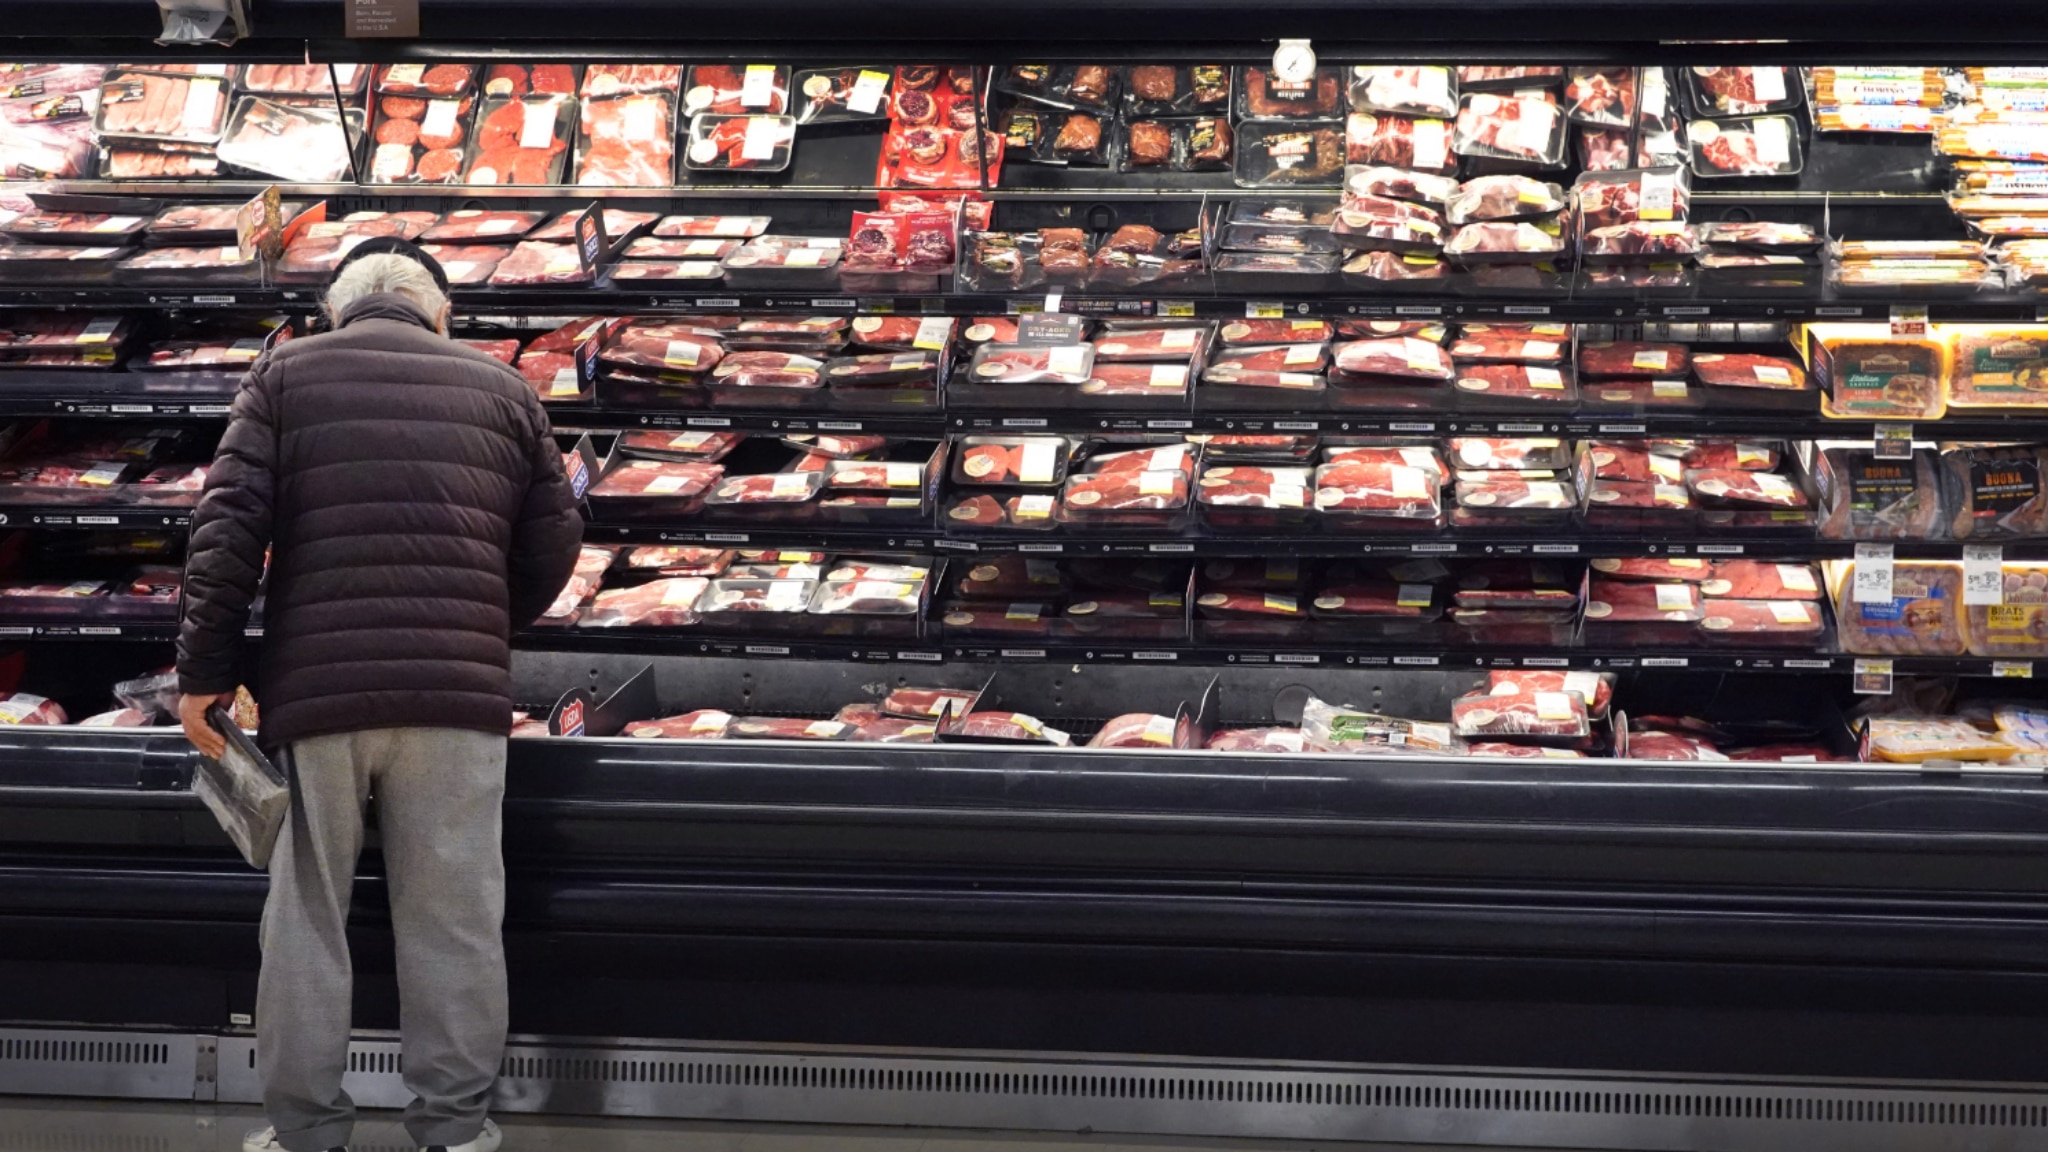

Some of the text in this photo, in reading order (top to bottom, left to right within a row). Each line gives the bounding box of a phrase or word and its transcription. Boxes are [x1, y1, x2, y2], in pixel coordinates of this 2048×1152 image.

[1864, 467, 1902, 478] BUONA
[1985, 471, 2023, 486] BUONA
[1991, 606, 2024, 615] BRATS
[564, 707, 579, 729] USDA
